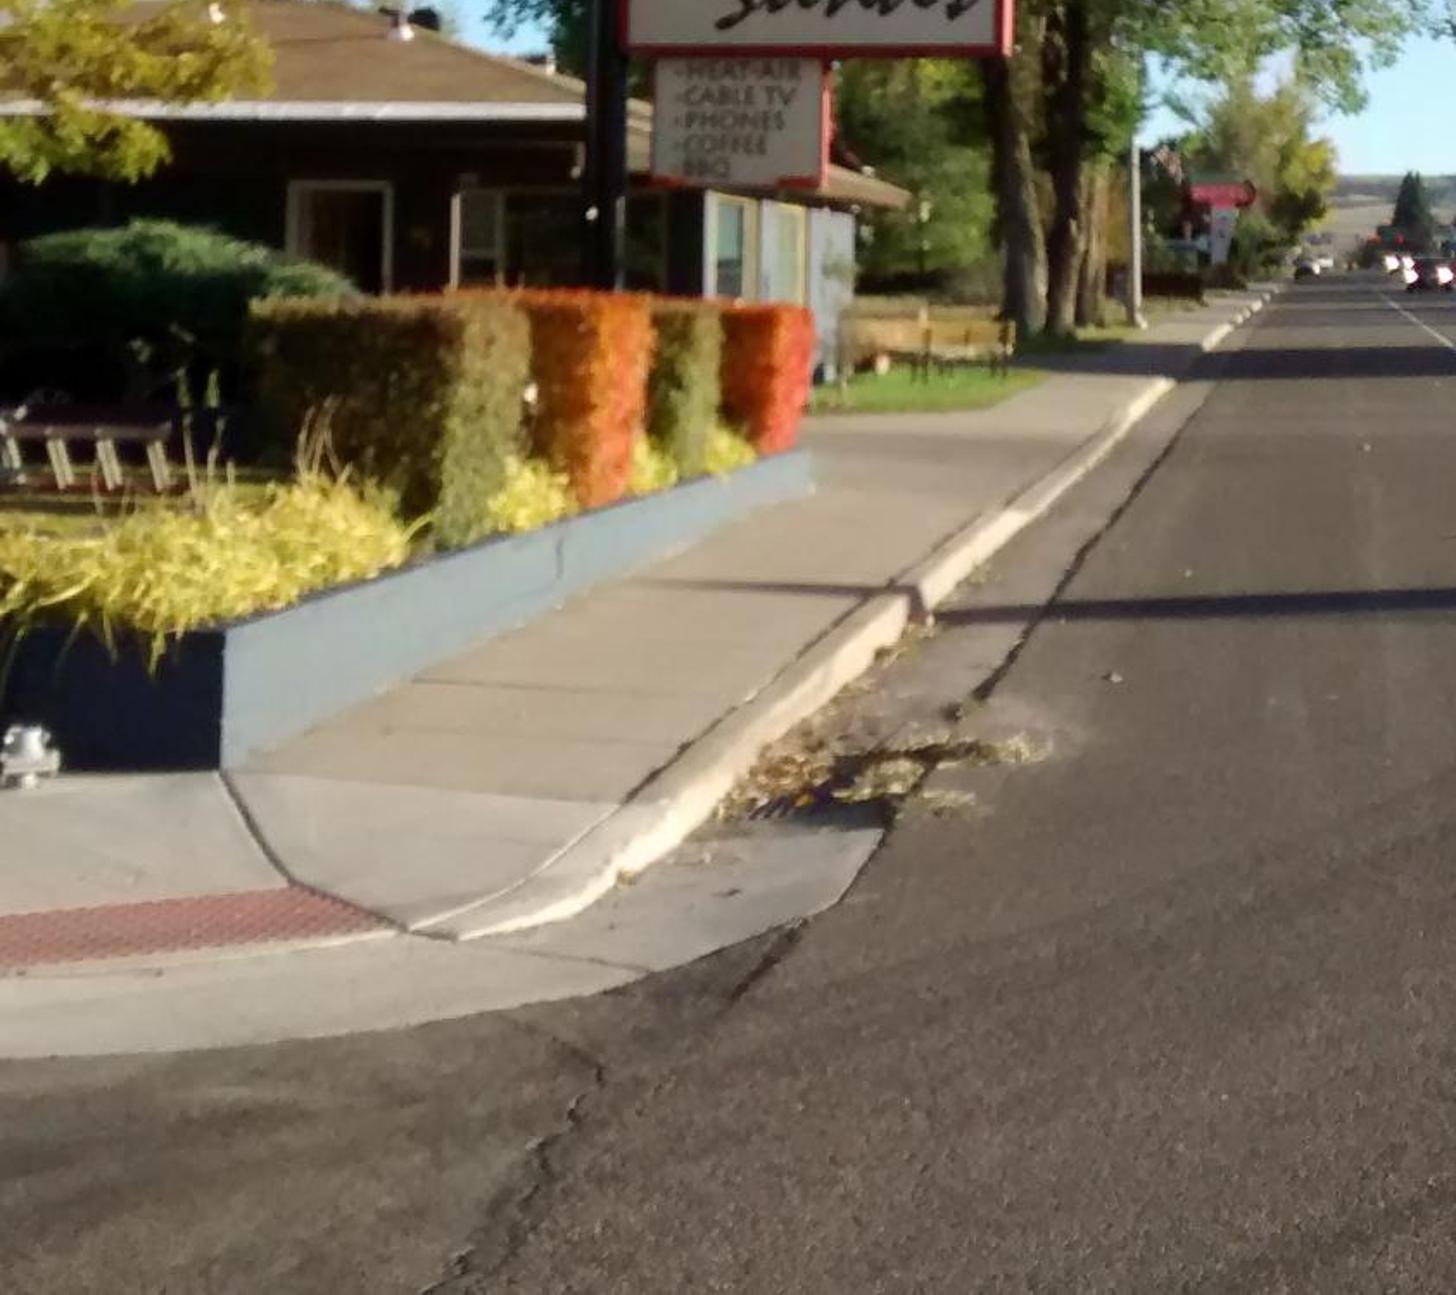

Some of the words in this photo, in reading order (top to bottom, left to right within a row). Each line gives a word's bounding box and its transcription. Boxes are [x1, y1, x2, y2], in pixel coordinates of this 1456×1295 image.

[684, 85, 755, 106] CABLE
[765, 85, 797, 106] TV
[684, 111, 785, 131] PHONES
